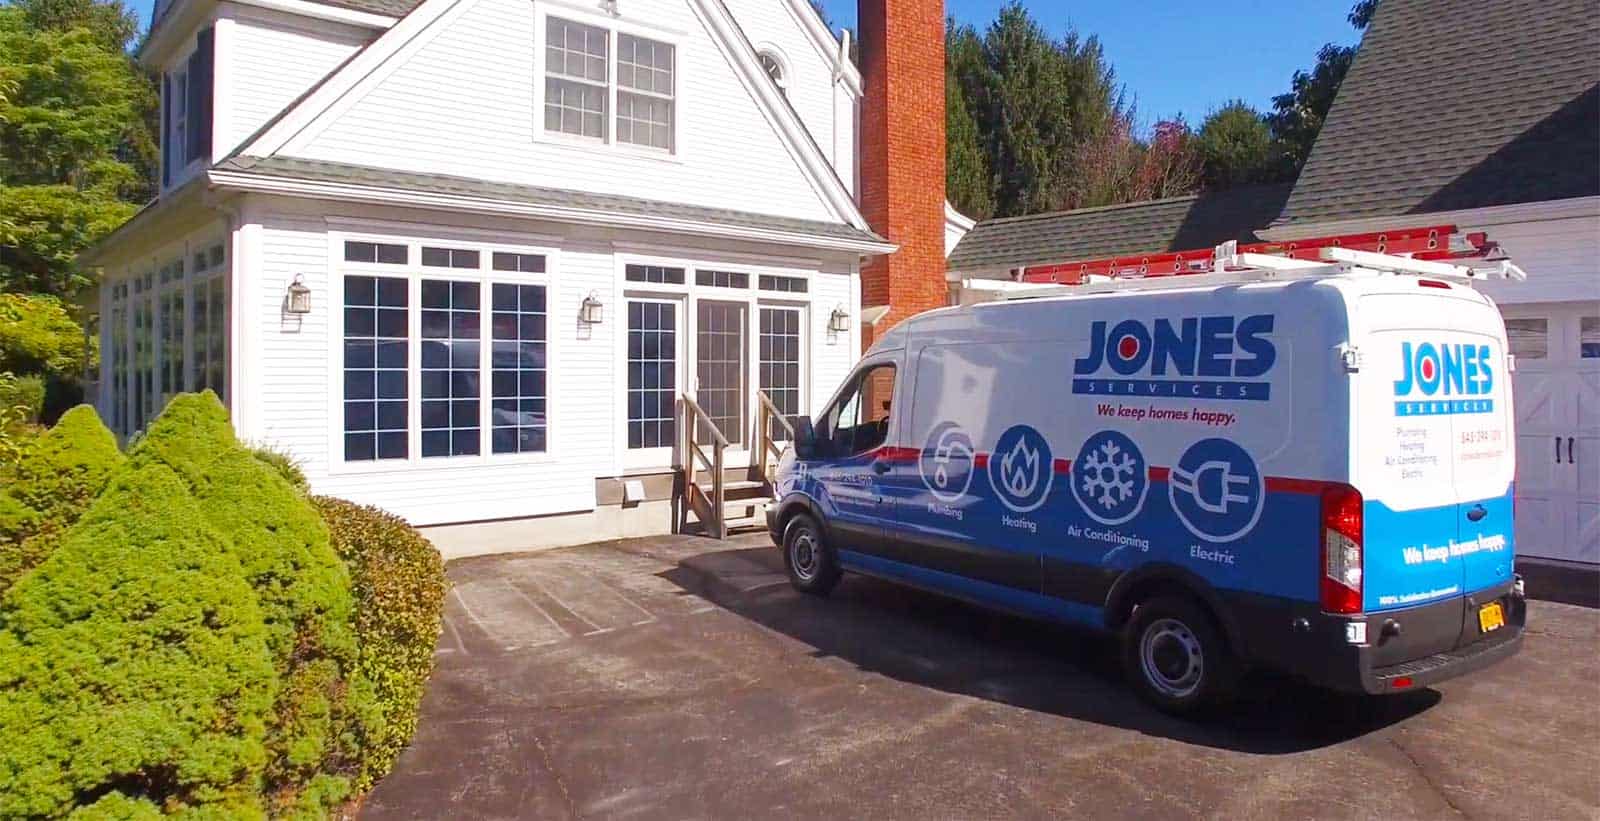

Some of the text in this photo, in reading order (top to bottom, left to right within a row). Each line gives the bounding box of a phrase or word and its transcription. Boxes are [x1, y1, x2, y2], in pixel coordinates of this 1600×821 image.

[1074, 314, 1276, 377] JONES
[1393, 341, 1493, 396] JONES
[1088, 381, 1248, 396] SERVICES
[1097, 404, 1236, 426] We keep homes happy.
[1001, 514, 1037, 533] Heating
[1067, 524, 1150, 552] Air Conditioning
[1189, 545, 1235, 565] Electric
[1403, 546, 1422, 565] We
[1422, 543, 1449, 564] keep
